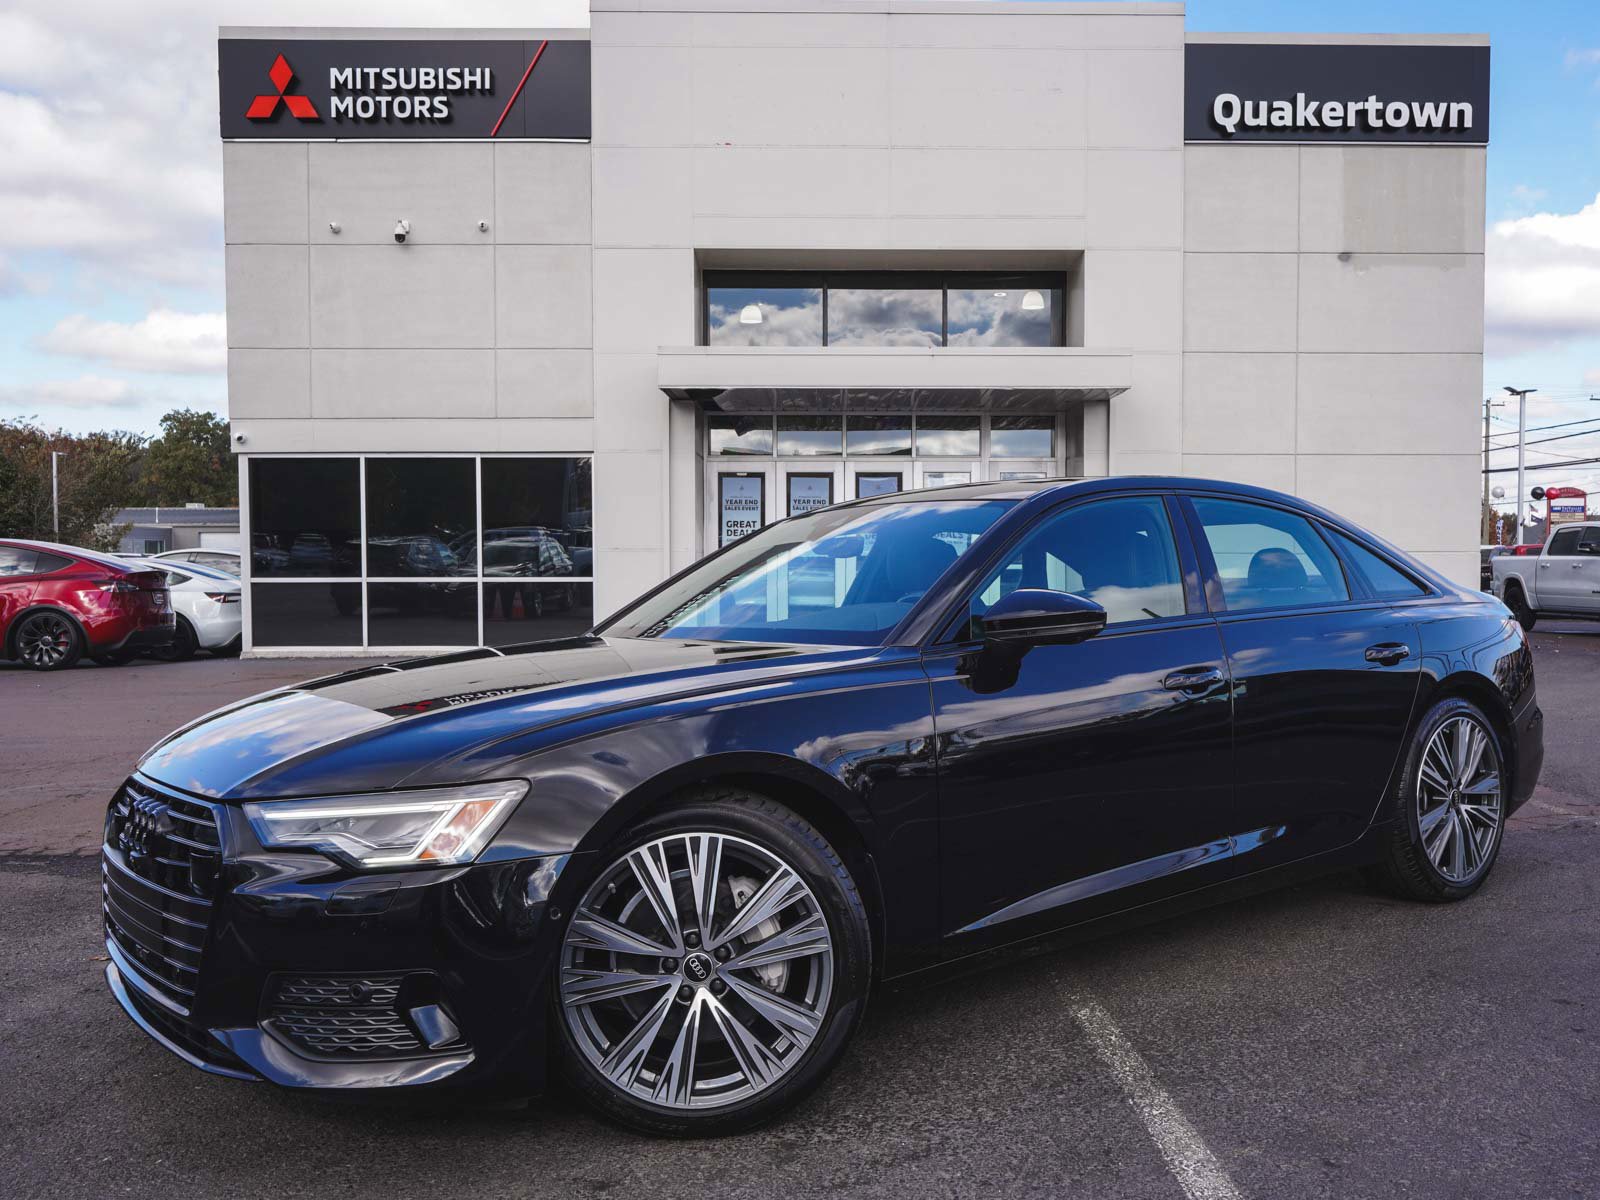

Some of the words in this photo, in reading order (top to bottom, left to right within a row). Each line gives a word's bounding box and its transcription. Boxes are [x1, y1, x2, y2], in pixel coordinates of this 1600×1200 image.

[329, 67, 491, 90] MITSUBISHI
[329, 95, 449, 119] MOTORS
[1213, 92, 1473, 133] Quakertown
[726, 520, 757, 528] GREAT
